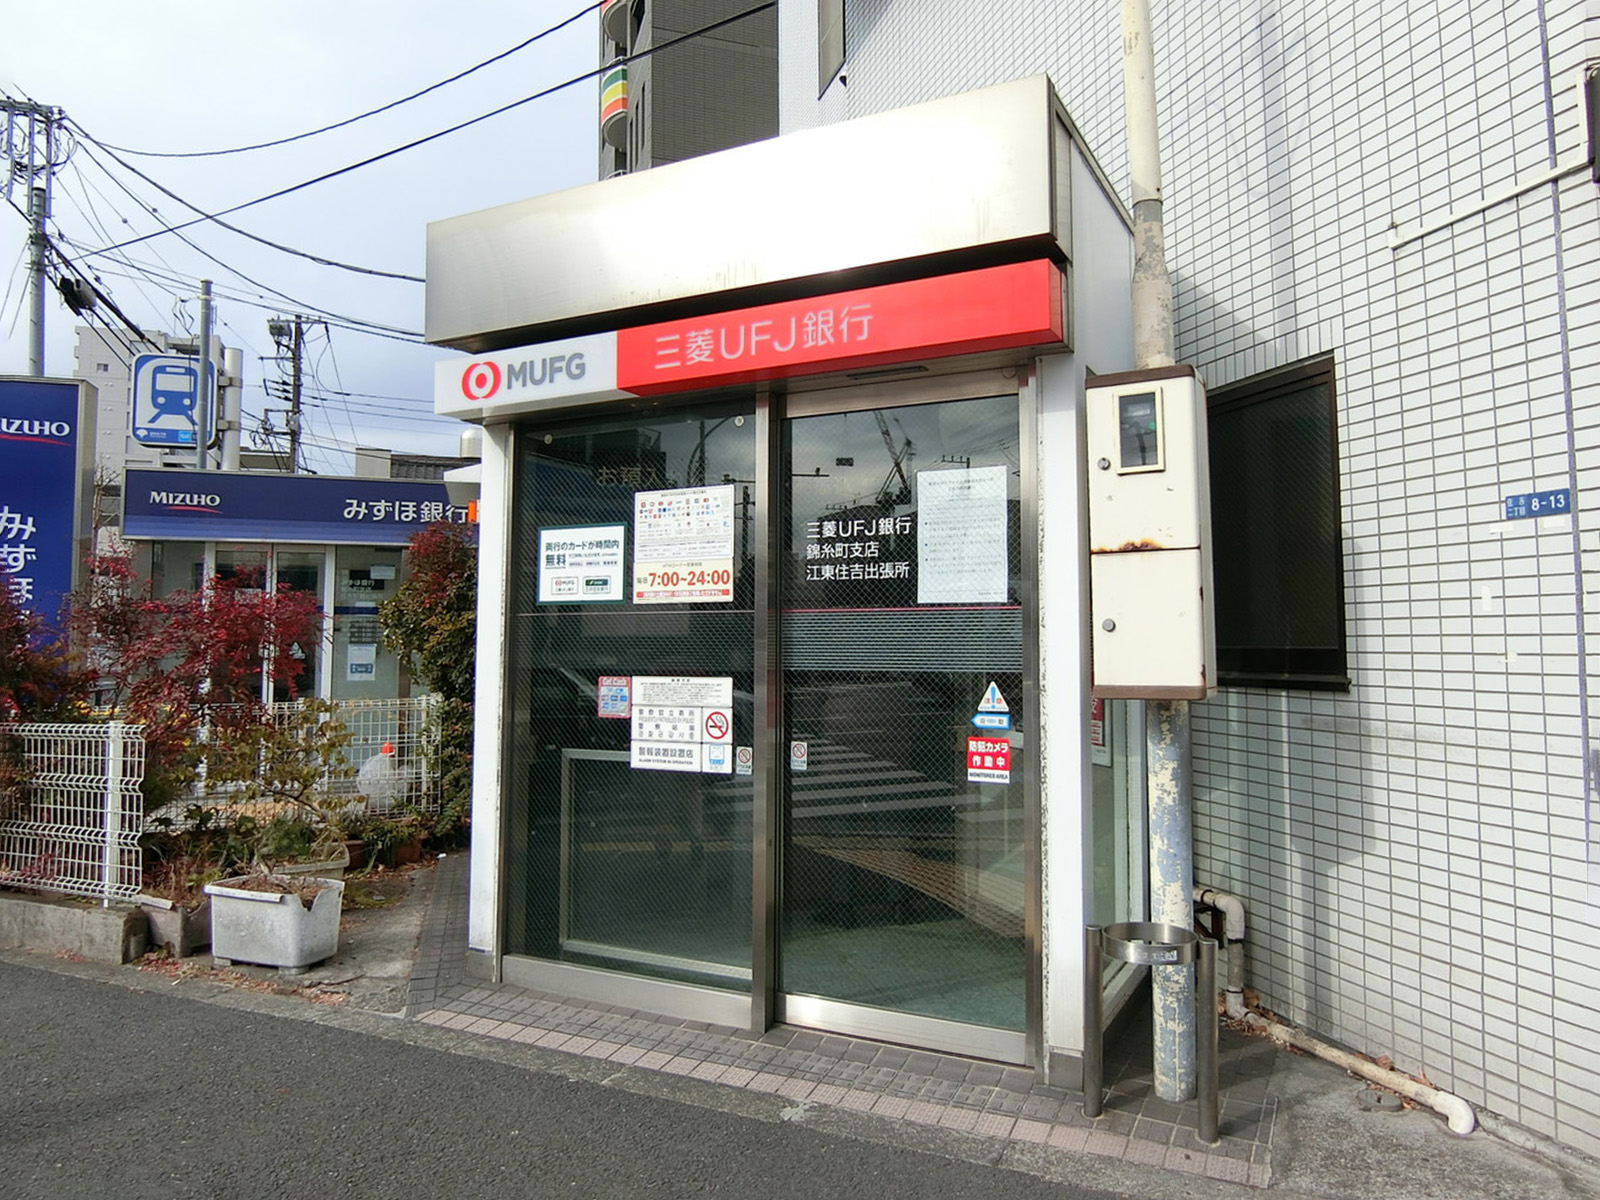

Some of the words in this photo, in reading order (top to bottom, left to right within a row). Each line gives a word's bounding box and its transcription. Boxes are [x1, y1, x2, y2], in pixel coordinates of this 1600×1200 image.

[655, 304, 874, 370] 三菱UFJ銀行
[507, 352, 586, 390] MUFG
[149, 491, 221, 507] MIZUHO
[1531, 494, 1566, 512] 8-13
[343, 499, 469, 524] みずほ銀行
[806, 516, 912, 539] 三菱UFJ銀行
[545, 553, 567, 567] 無料
[806, 541, 880, 560] 錦糸町支店
[806, 561, 911, 582] 江東住吉出張所
[969, 740, 1009, 754] 防犯カメラ
[972, 754, 1005, 768] 作動中
